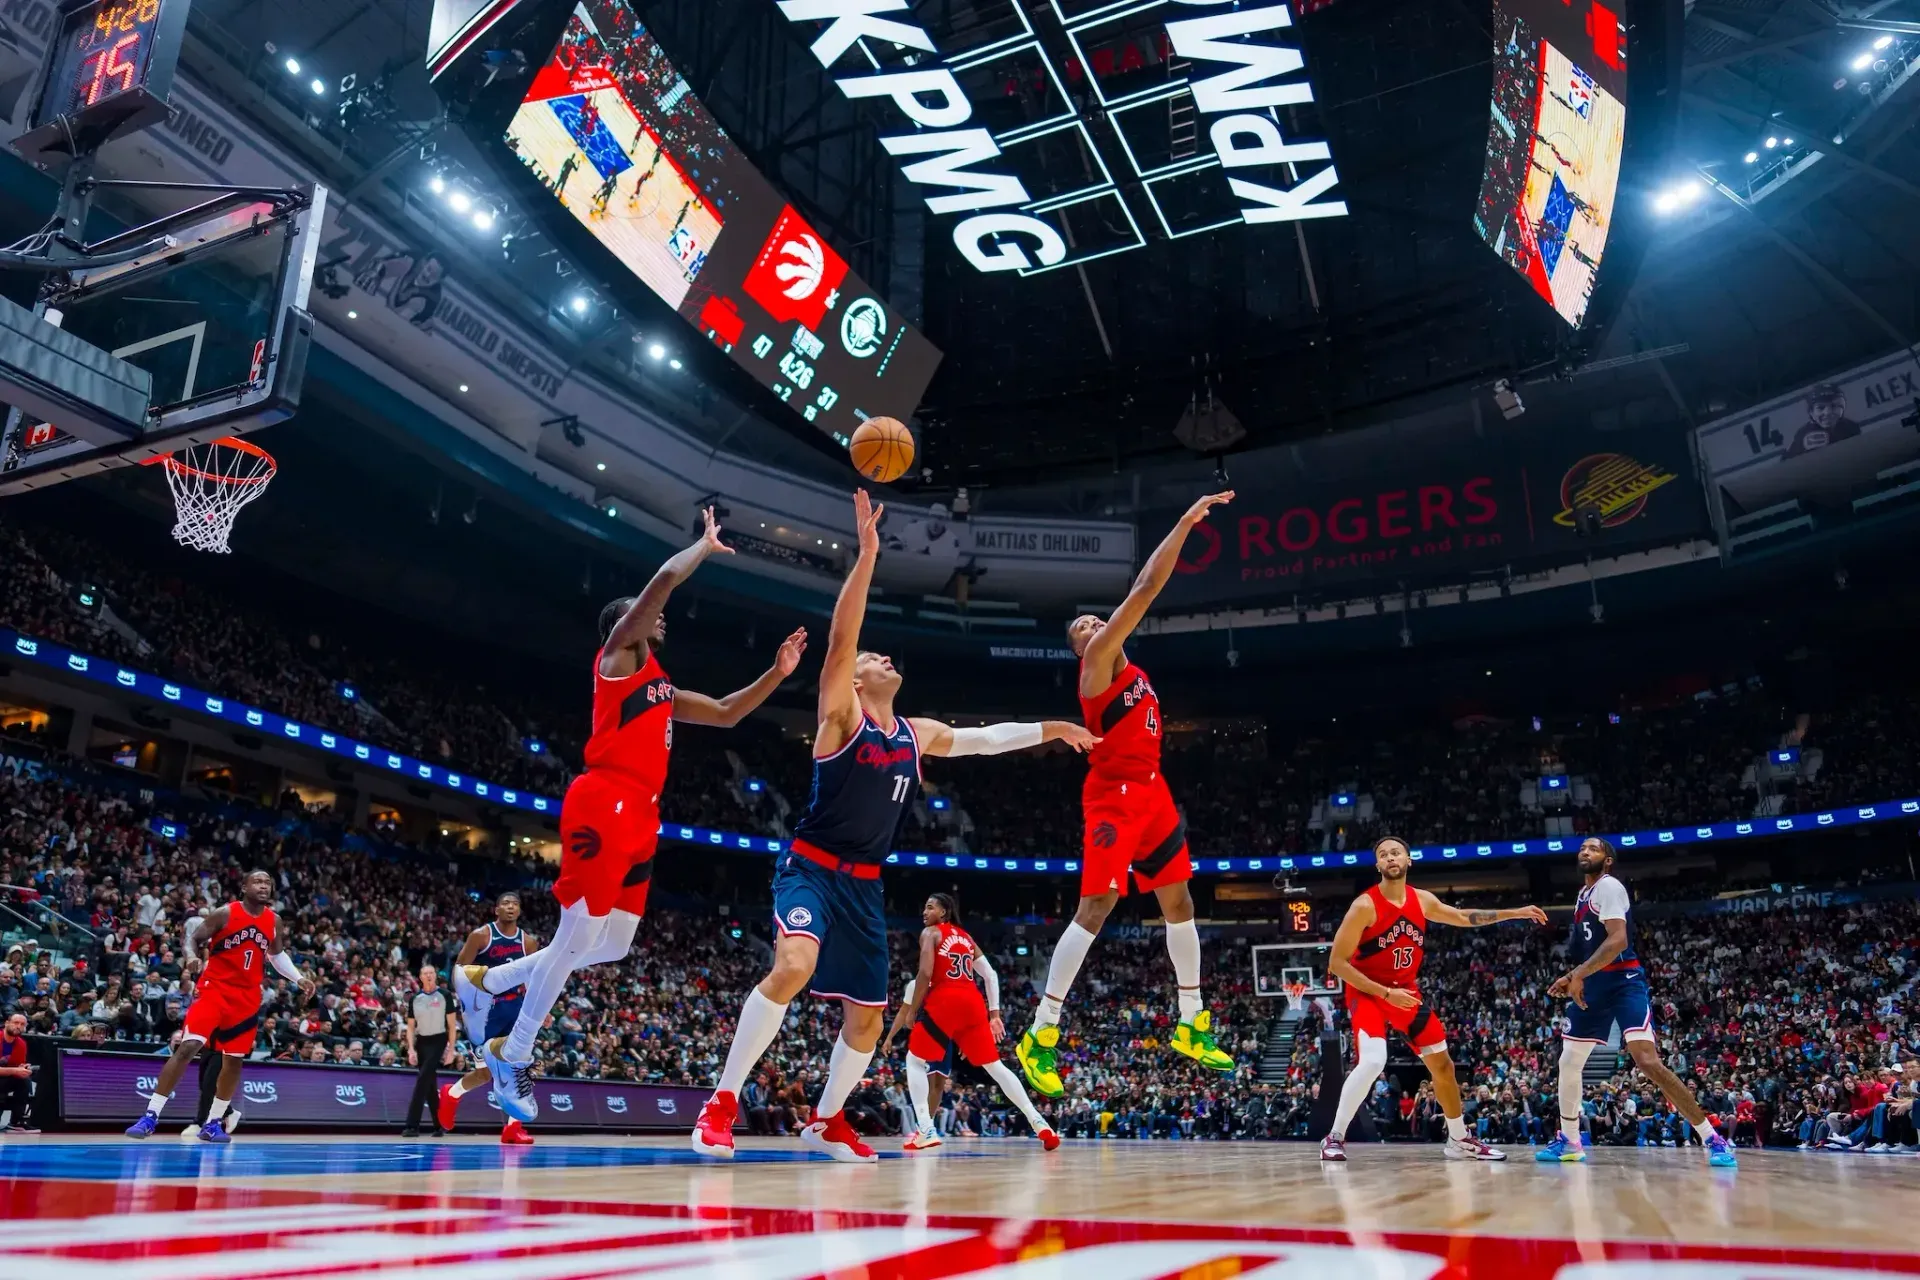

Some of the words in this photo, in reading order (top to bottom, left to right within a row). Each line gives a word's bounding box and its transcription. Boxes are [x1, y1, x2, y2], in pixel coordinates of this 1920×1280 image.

[1164, 0, 1348, 224] KPM
[775, 0, 1066, 273] KPMG
[434, 297, 499, 353] HAROLD
[752, 334, 773, 359] 47
[779, 351, 815, 390] 4:26
[781, 386, 792, 402] 2
[817, 386, 838, 411] 37
[1863, 371, 1920, 409] ALEX
[803, 405, 817, 422] 15
[1743, 416, 1784, 454] 14
[1238, 476, 1499, 560] ROGERS
[975, 530, 1038, 552] MATTIAS
[1042, 532, 1101, 554] OHLUND
[1240, 560, 1303, 582] Proud
[1312, 549, 1398, 571] Partner
[1410, 535, 1452, 558] and
[1462, 530, 1502, 552] Fan
[989, 646, 1045, 660] VANCOUVER
[1146, 706, 1157, 736] 4
[891, 774, 911, 804] 11
[1288, 902, 1311, 914] 4:26
[1293, 913, 1309, 932] 15
[1378, 920, 1424, 949] RAPTORS
[1582, 921, 1593, 941] 5
[243, 949, 254, 971] 1
[945, 951, 974, 981] 30
[1391, 946, 1415, 970] 13
[243, 1080, 276, 1095] aws
[335, 1084, 363, 1098] aws
[550, 1093, 572, 1105] aws
[606, 1095, 626, 1107] aws
[657, 1098, 675, 1108] aws
